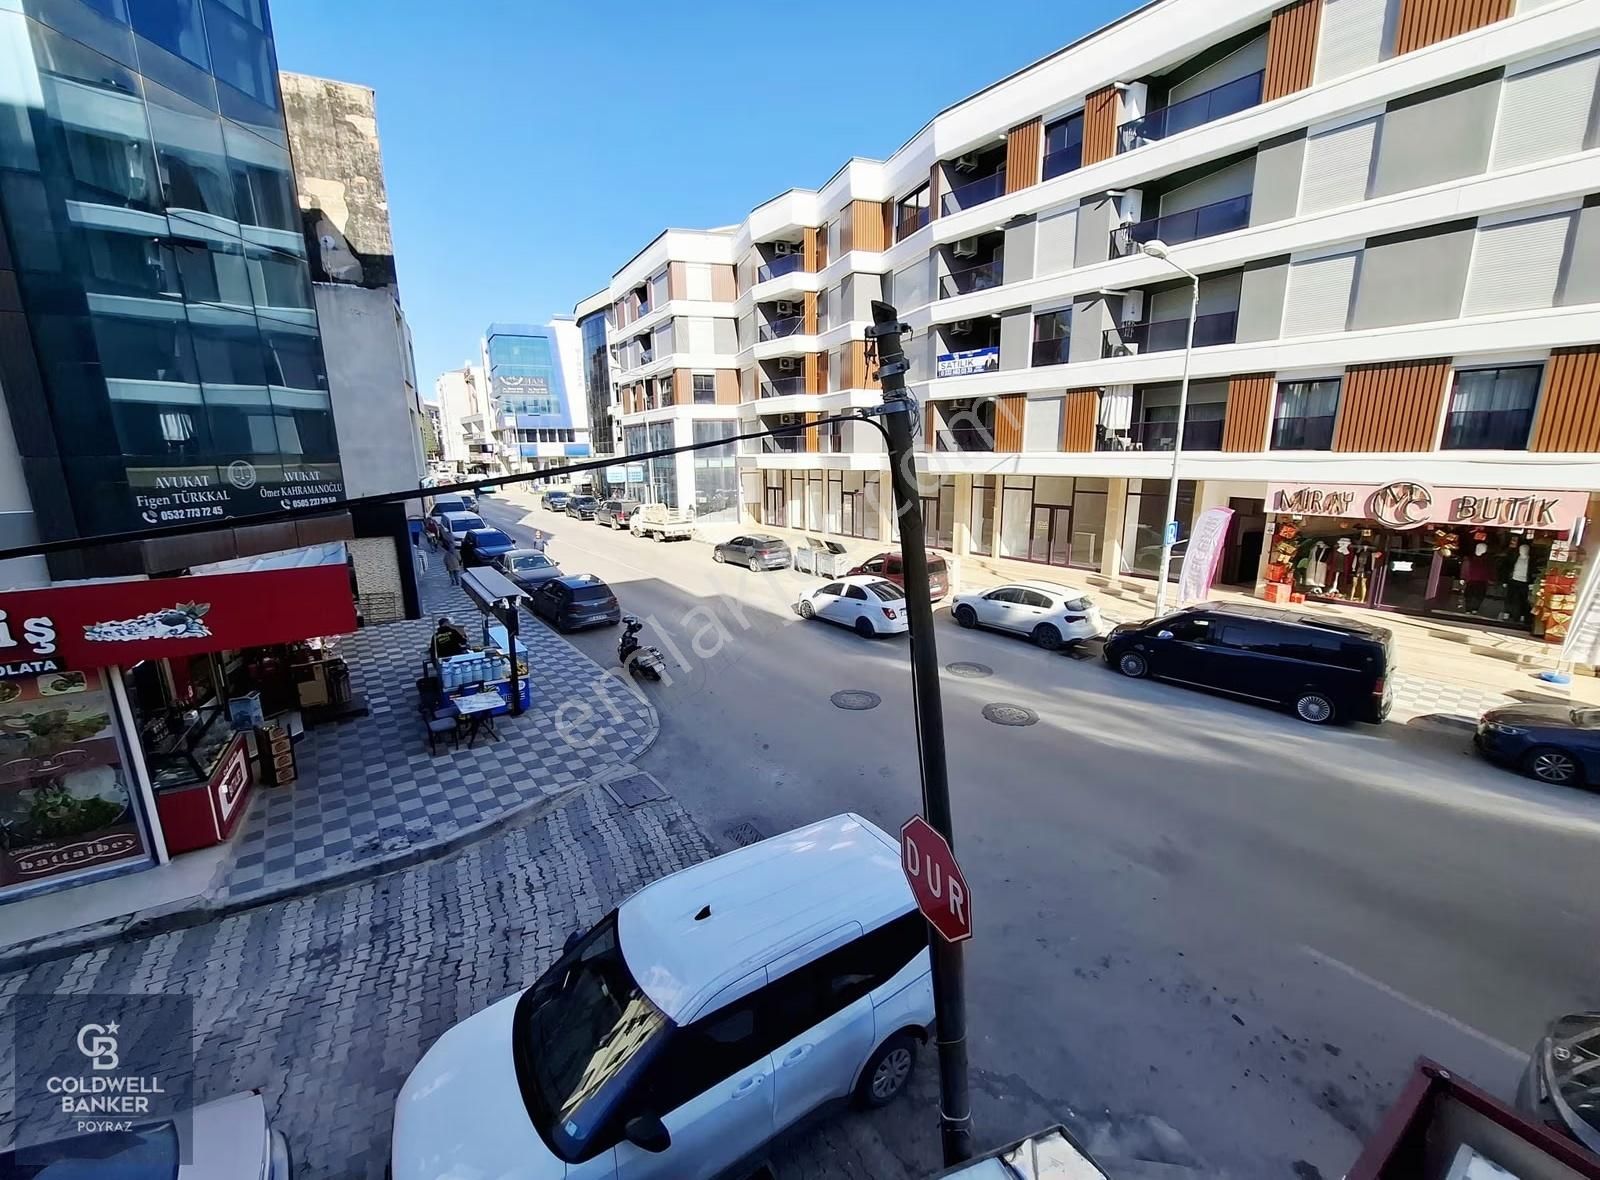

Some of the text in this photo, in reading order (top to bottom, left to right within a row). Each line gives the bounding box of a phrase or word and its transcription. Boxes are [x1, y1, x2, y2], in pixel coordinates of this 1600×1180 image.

[941, 359, 974, 370] SATILIK
[155, 475, 209, 489] AVUKAT
[283, 471, 320, 482] AVUKAT
[260, 482, 343, 498] Ömer KAHRAMANOĞLU
[136, 490, 231, 510] Figen TÜRKKAL
[160, 505, 224, 521] 0532 773 72 45
[906, 836, 965, 926] DUR
